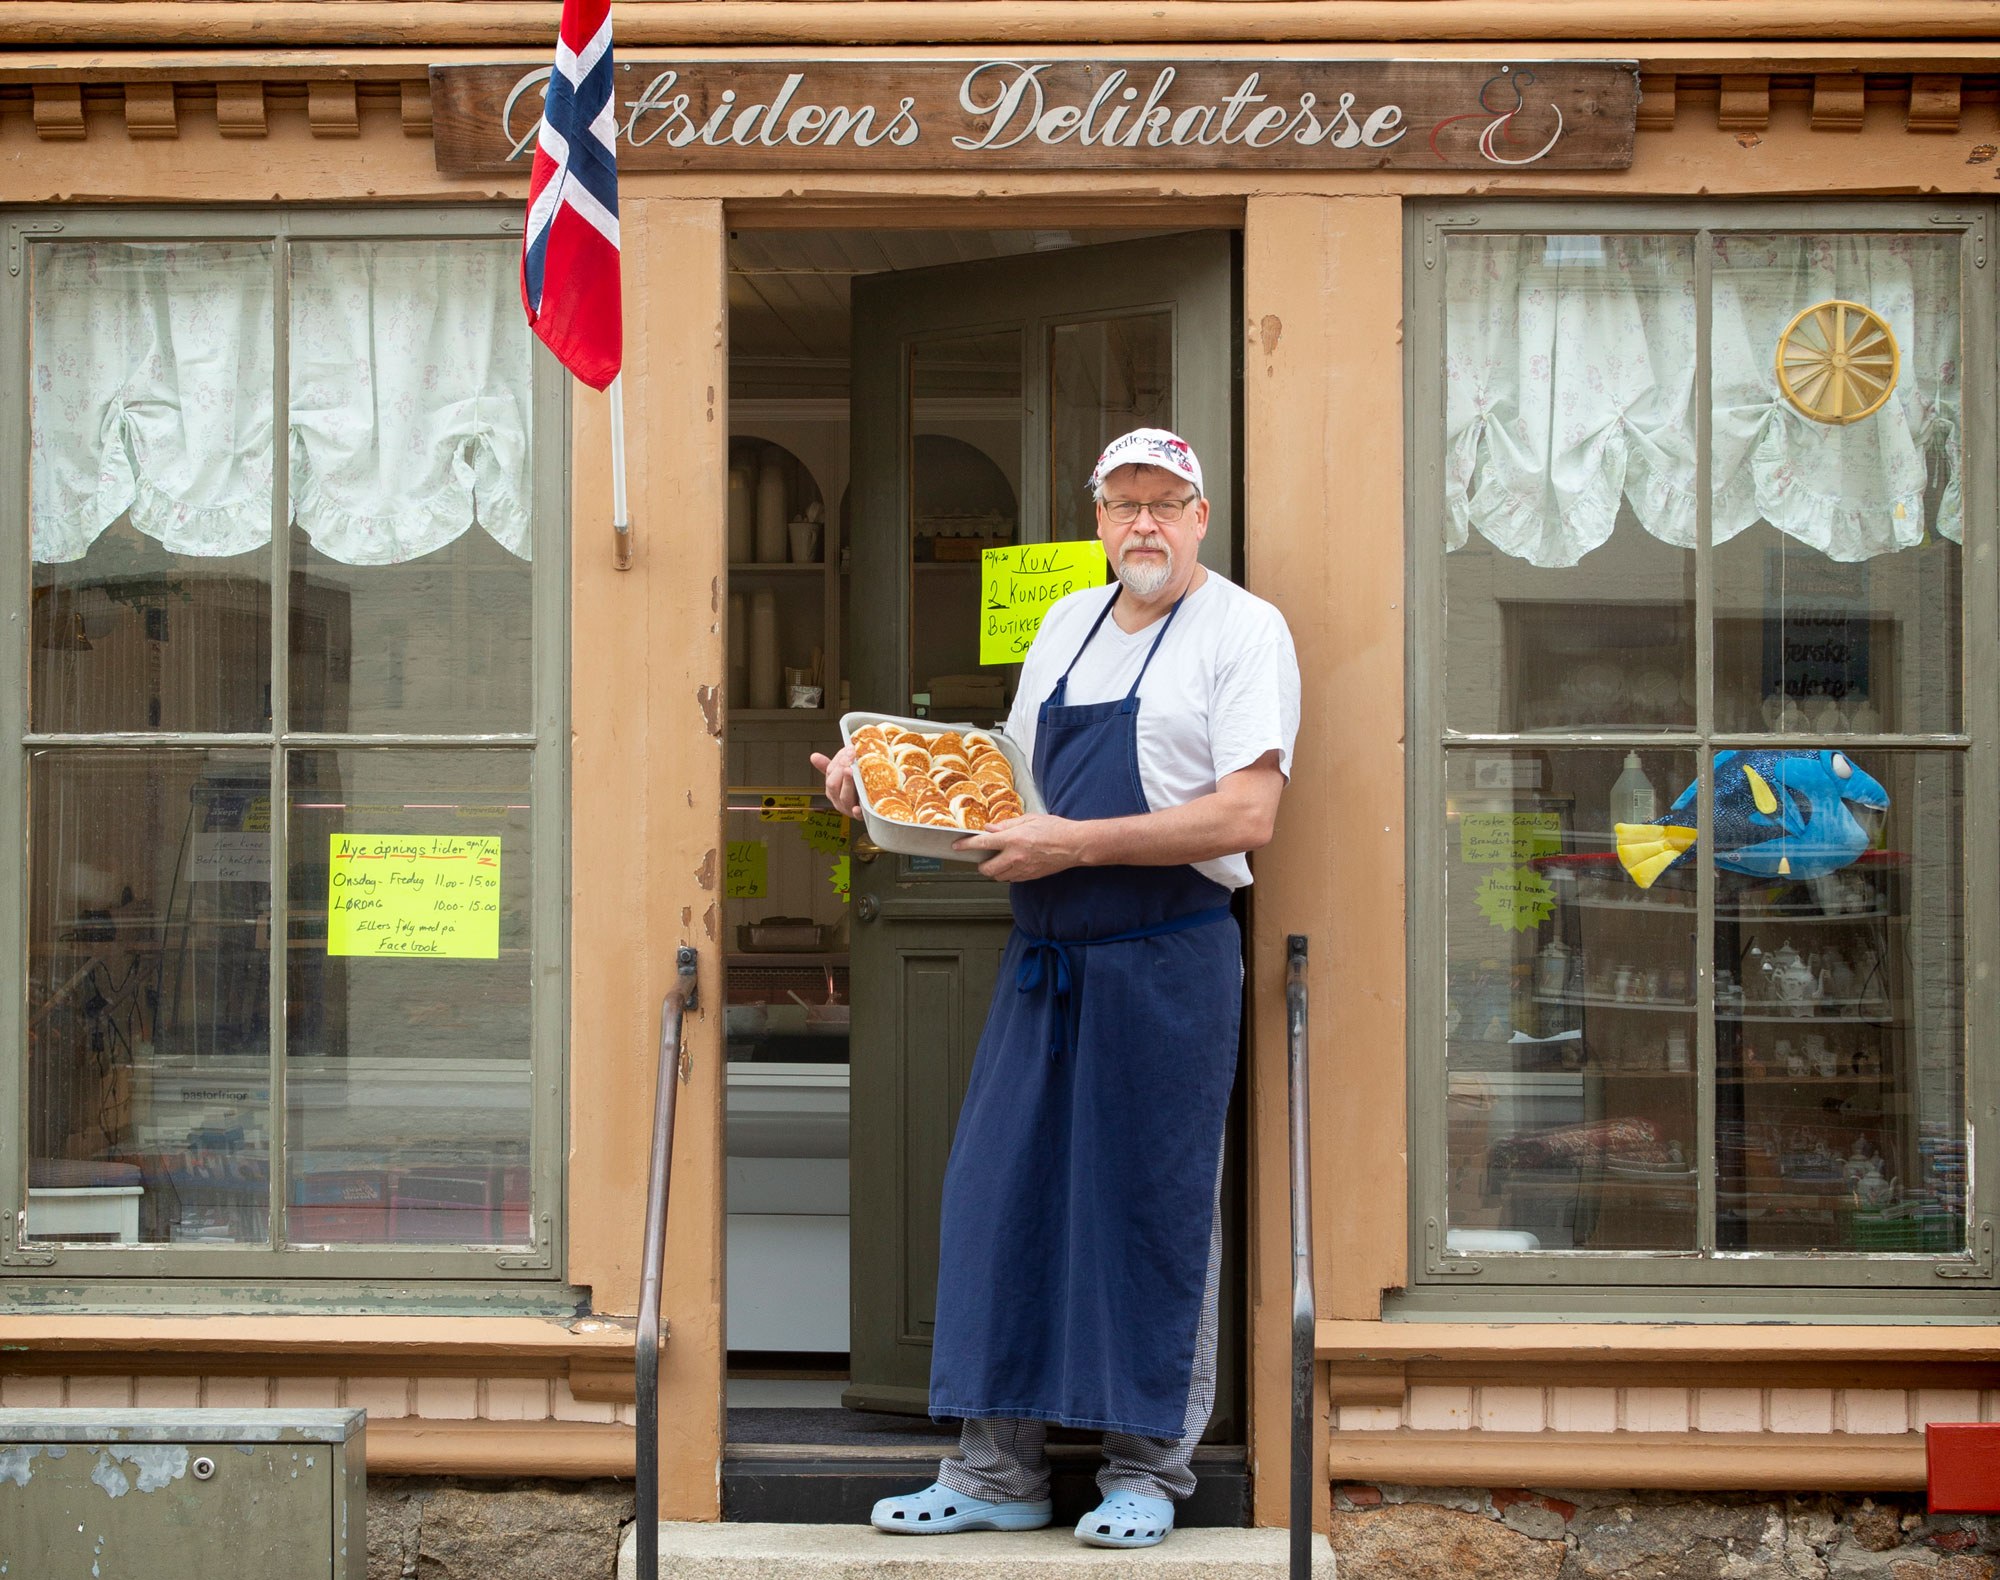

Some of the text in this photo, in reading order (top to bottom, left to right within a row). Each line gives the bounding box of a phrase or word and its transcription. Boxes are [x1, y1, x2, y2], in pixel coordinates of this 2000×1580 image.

[502, 60, 1406, 162] tsidens Delikatesse
[1019, 548, 1059, 573] KUN
[988, 580, 1007, 607] 2
[1009, 577, 1073, 604] KUNDER
[987, 615, 1041, 636] BUTIKKE
[340, 839, 367, 863] Nye
[432, 838, 465, 854] tider
[356, 920, 391, 932] Ellers
